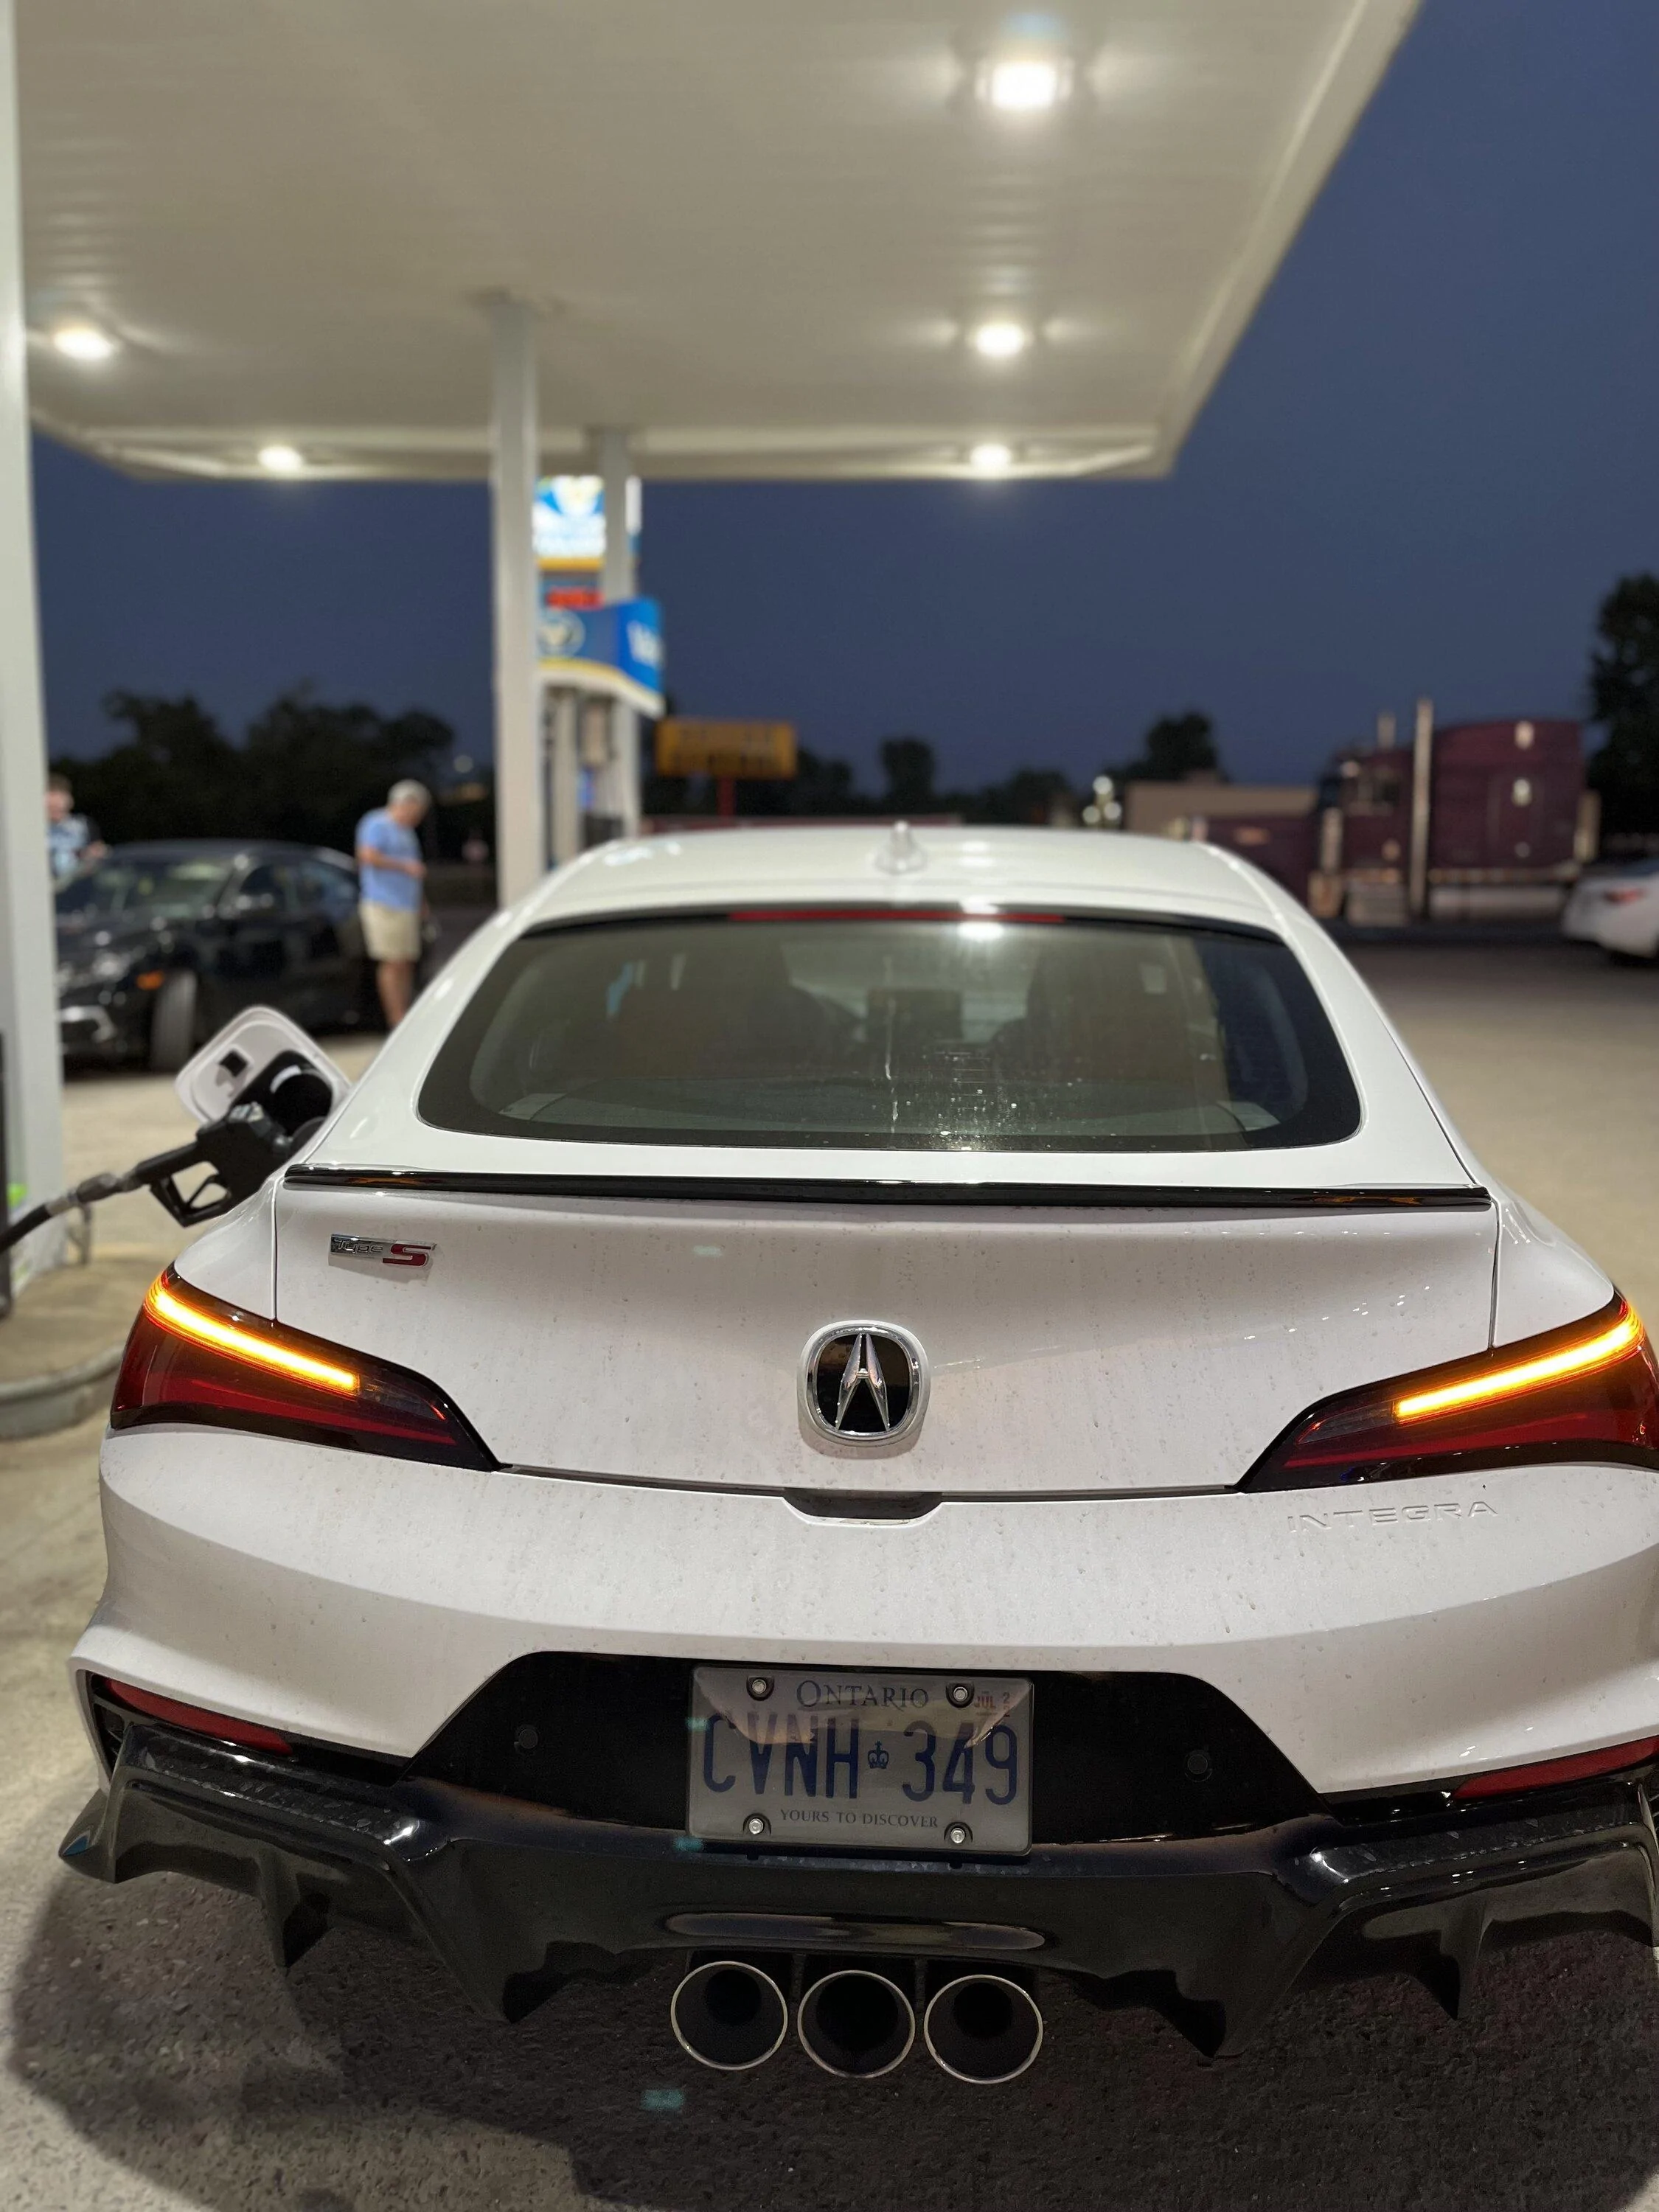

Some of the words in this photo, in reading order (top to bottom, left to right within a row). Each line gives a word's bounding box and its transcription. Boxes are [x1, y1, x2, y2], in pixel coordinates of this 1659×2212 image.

[333, 1239, 383, 1254] Type
[383, 1242, 432, 1267] S
[1287, 1500, 1499, 1533] INTEGRA
[796, 1680, 929, 1711] ONTARIO
[703, 1714, 859, 1799] CVNH
[902, 1720, 1018, 1805] 349
[780, 1809, 830, 1823] YOURS
[836, 1811, 856, 1825] TO
[862, 1812, 939, 1828] DISCOVER
